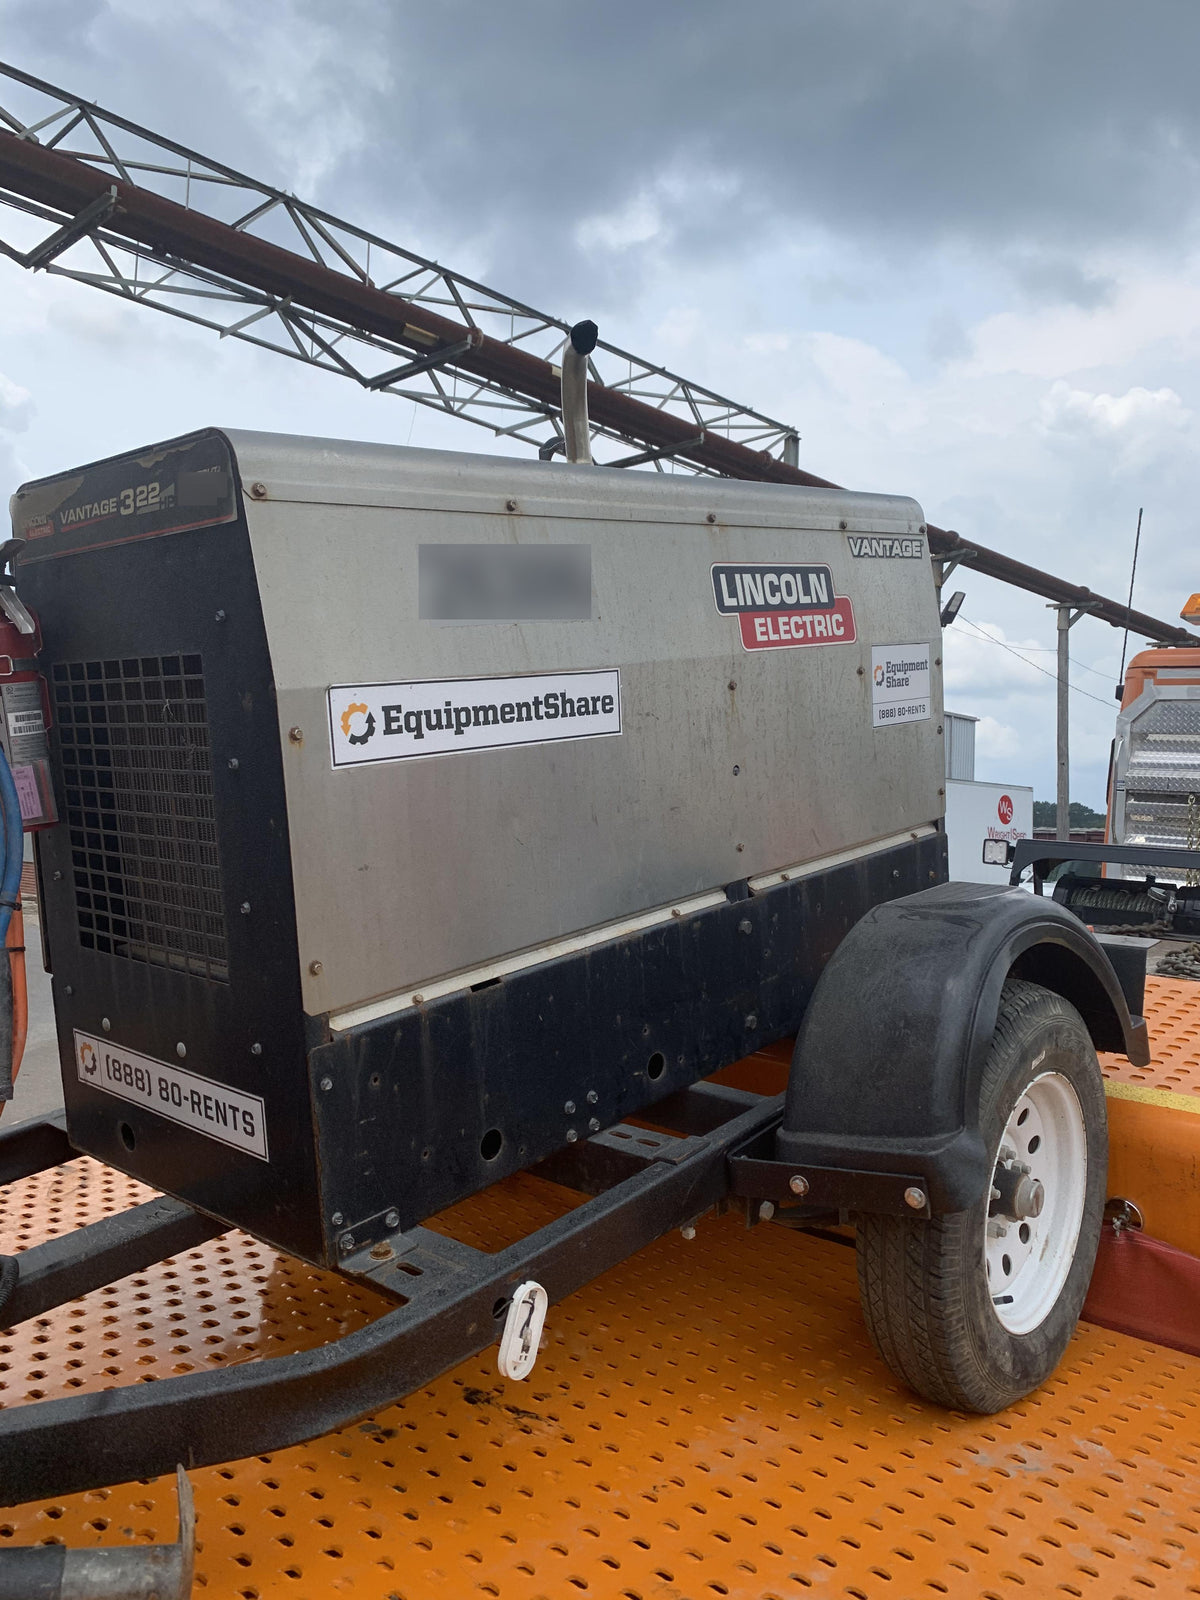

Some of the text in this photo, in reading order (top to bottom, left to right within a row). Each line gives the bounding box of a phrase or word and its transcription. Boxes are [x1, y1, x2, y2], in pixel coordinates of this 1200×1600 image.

[60, 497, 118, 525] VANTAGE
[120, 482, 161, 516] 322
[847, 536, 923, 559] VANTAGE
[719, 573, 829, 607] LINCOLN
[754, 613, 845, 642] ELECTRIC
[885, 659, 928, 675] Equipment
[886, 676, 910, 688] Share
[381, 691, 614, 740] EquipmentShare
[879, 704, 926, 719] (888) 80-RENTS
[105, 1053, 256, 1138] (888) 80-RENTS
